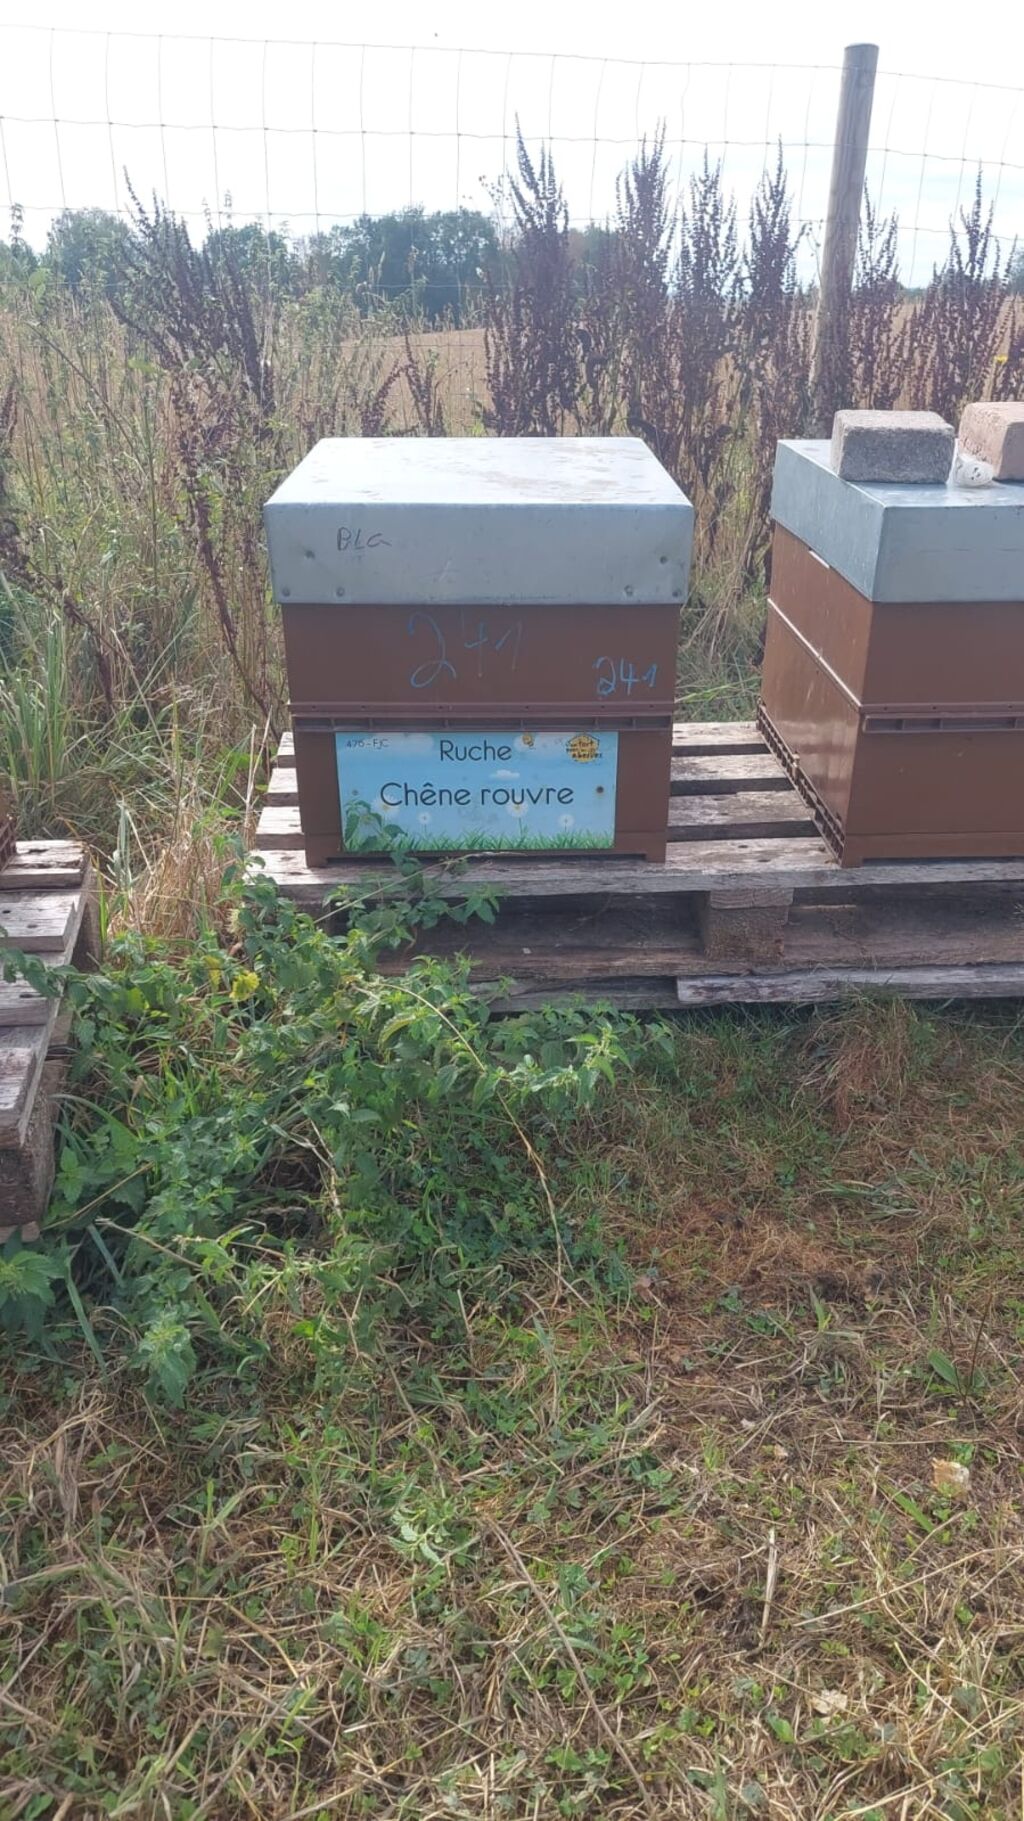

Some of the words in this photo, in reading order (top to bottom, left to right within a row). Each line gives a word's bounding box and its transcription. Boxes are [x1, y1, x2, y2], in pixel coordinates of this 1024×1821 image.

[593, 656, 658, 696] 241
[440, 740, 512, 762] Ruche
[380, 782, 472, 806] Chêne
[481, 786, 574, 806] rouvre
